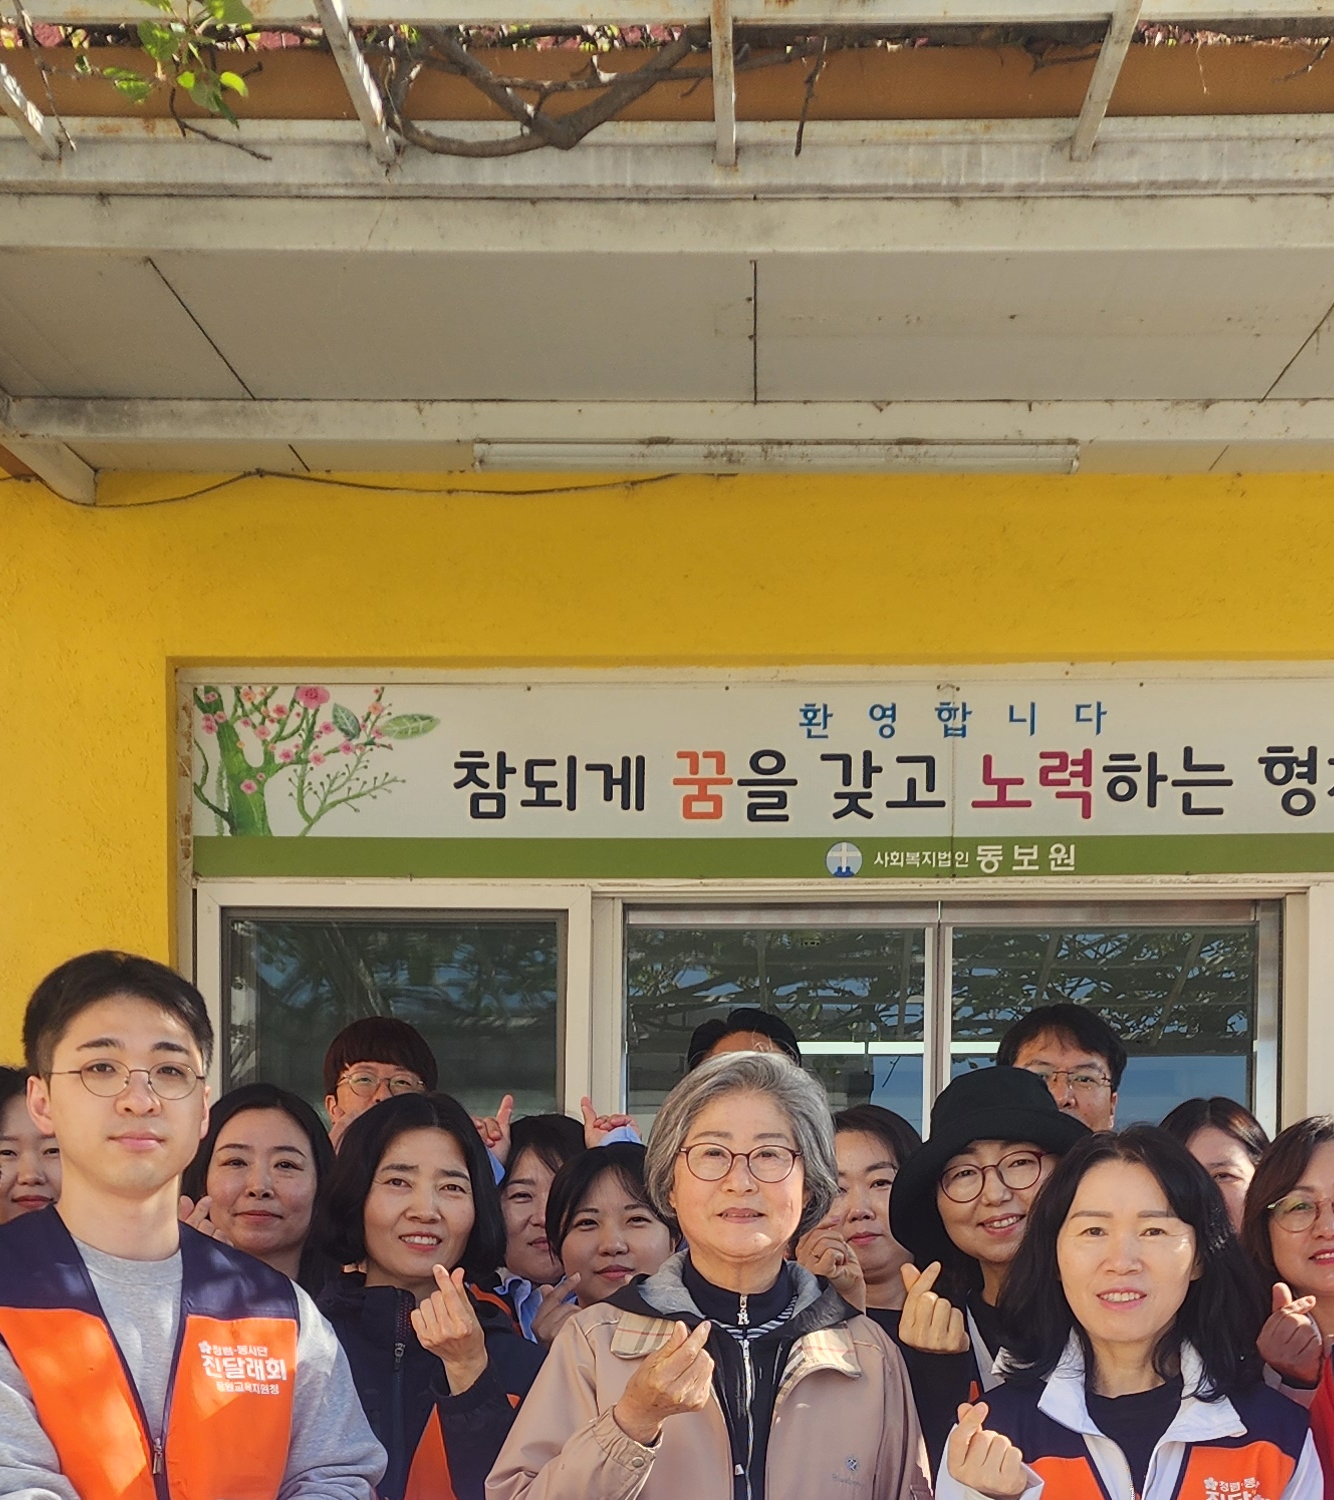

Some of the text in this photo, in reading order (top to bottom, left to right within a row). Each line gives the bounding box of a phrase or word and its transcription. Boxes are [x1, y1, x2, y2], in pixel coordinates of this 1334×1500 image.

[798, 701, 1108, 740] 환영합니다
[454, 750, 646, 820] 참되게
[672, 750, 798, 823] 꿈을
[820, 750, 947, 821] 갖고
[971, 748, 1234, 820] 노력하는
[873, 843, 1077, 873] 사회복지법인 동보원
[202, 1355, 288, 1381] 진달래회
